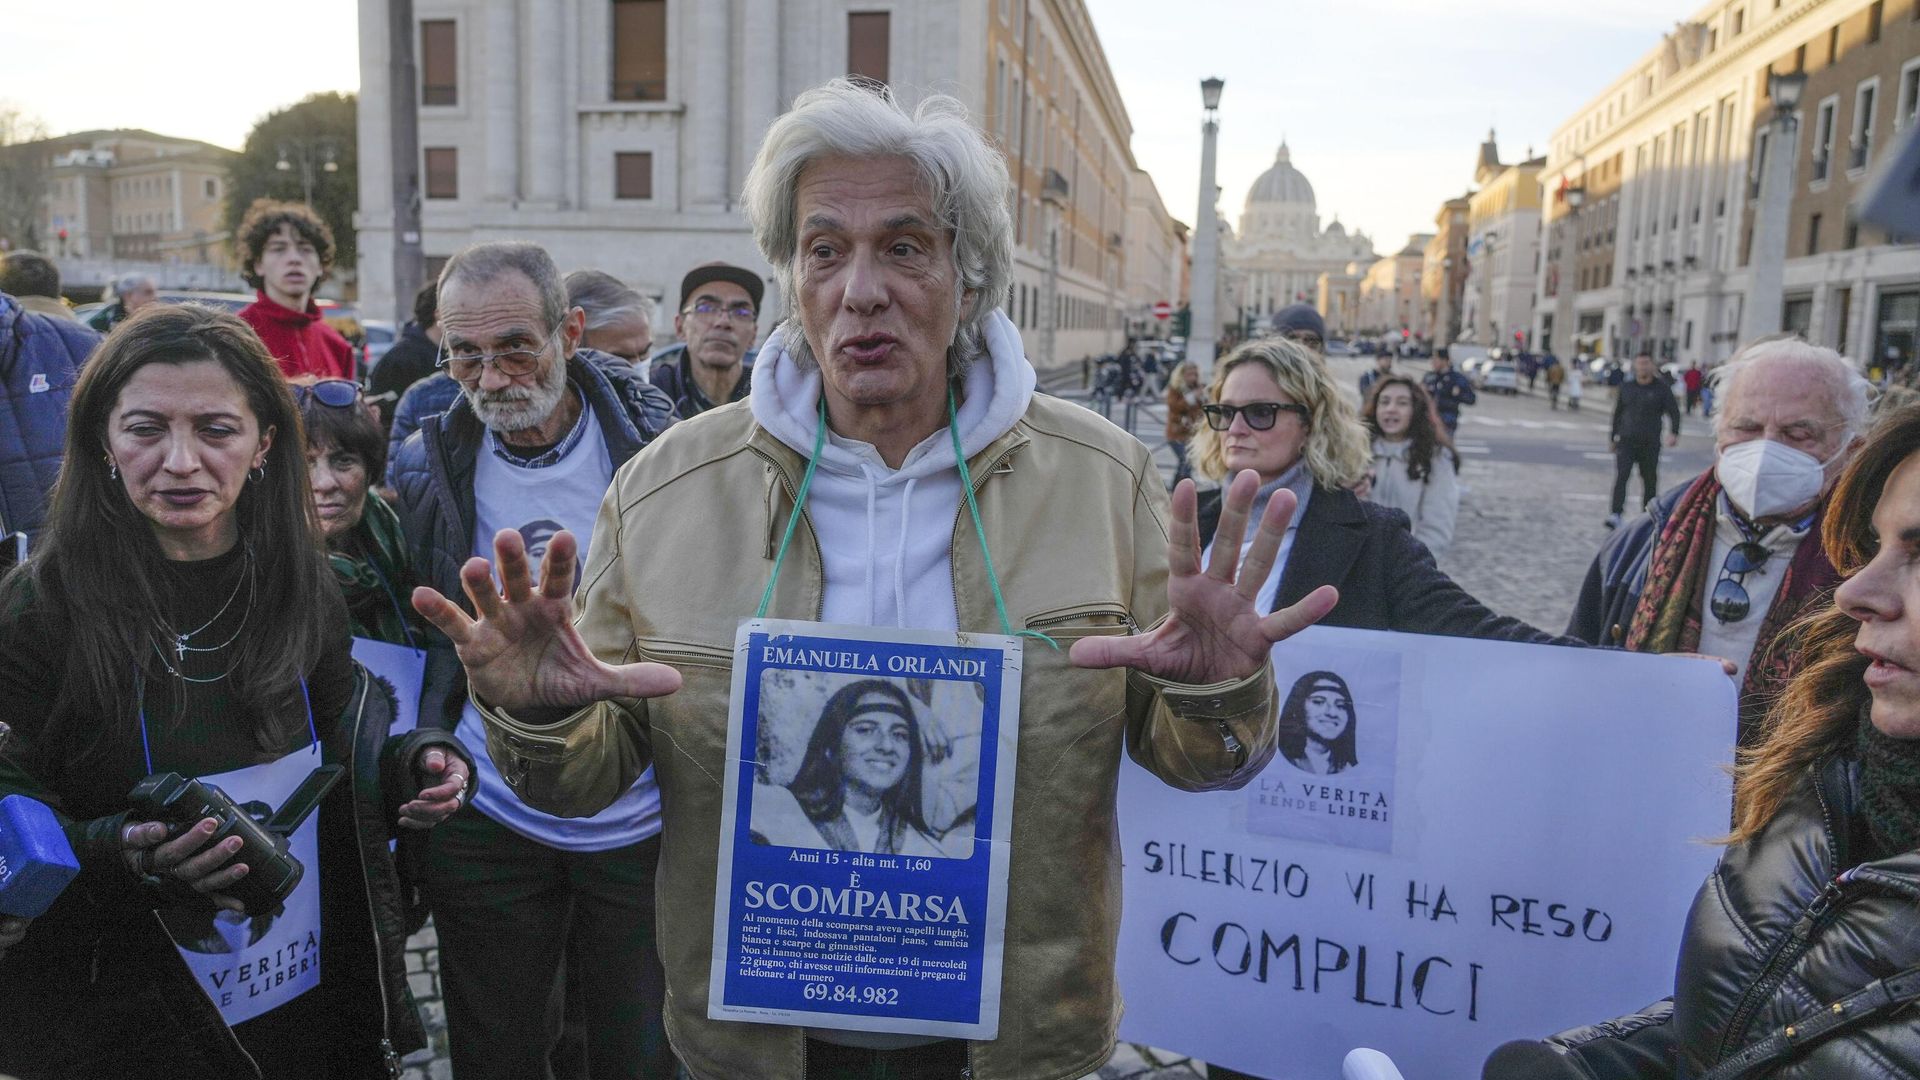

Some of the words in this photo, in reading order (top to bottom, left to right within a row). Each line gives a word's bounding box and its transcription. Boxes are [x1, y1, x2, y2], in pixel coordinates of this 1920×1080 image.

[762, 646, 880, 671] EMANUELA
[887, 655, 987, 677] ORLANDI
[1261, 779, 1286, 793] LA
[1259, 794, 1318, 812] RENDE
[1328, 803, 1388, 822] LIBERI
[788, 850, 820, 863] Anni
[825, 853, 840, 865] 15
[852, 854, 875, 867] alta
[879, 859, 899, 869] mt.
[905, 858, 932, 871] 1,60
[849, 871, 861, 888] È
[1144, 841, 1309, 898] SILENZIO
[1345, 871, 1374, 910] VI
[1406, 880, 1458, 924] HA
[1490, 894, 1612, 942] RESO
[744, 880, 969, 925] SCOMPARSA
[742, 924, 761, 934] neri
[766, 926, 772, 934] e
[777, 925, 798, 938] lisci,
[803, 928, 848, 940] indossava
[853, 934, 896, 944] pantaloni
[901, 935, 928, 946] jeans,
[933, 938, 969, 948] camicia
[743, 913, 754, 922] Al
[757, 916, 799, 926] momento
[801, 917, 823, 928] della
[825, 919, 873, 931] scomparsa
[876, 923, 902, 933] aveva
[904, 925, 935, 936] capelli
[937, 927, 969, 939] lunghi,
[741, 934, 771, 945] bianca
[774, 938, 780, 946] e
[782, 939, 811, 950] scarpe
[815, 940, 826, 949] da
[828, 941, 877, 953] ginnastica.
[740, 955, 752, 965] 22
[753, 957, 787, 969] giugno,
[788, 959, 802, 970] chi
[804, 961, 833, 971] avesse
[834, 962, 853, 973] utili
[854, 965, 913, 977] informazioni
[914, 967, 920, 977] è
[921, 971, 956, 981] pregato
[957, 971, 966, 981] di
[741, 945, 760, 955] Non
[762, 946, 770, 955] si
[773, 947, 801, 958] hanno
[803, 950, 819, 959] sue
[821, 951, 852, 962] notizie
[854, 953, 877, 964] dalle
[879, 956, 894, 965] ore
[898, 956, 909, 965] 19
[910, 957, 920, 967] di
[922, 959, 968, 970] mercoledì
[1160, 912, 1483, 1021] COMPLICI
[248, 952, 318, 999] LIBERI
[739, 967, 784, 979] telefonare
[787, 970, 796, 980] al
[799, 973, 835, 983] numero
[803, 983, 899, 1005] 69.84.982
